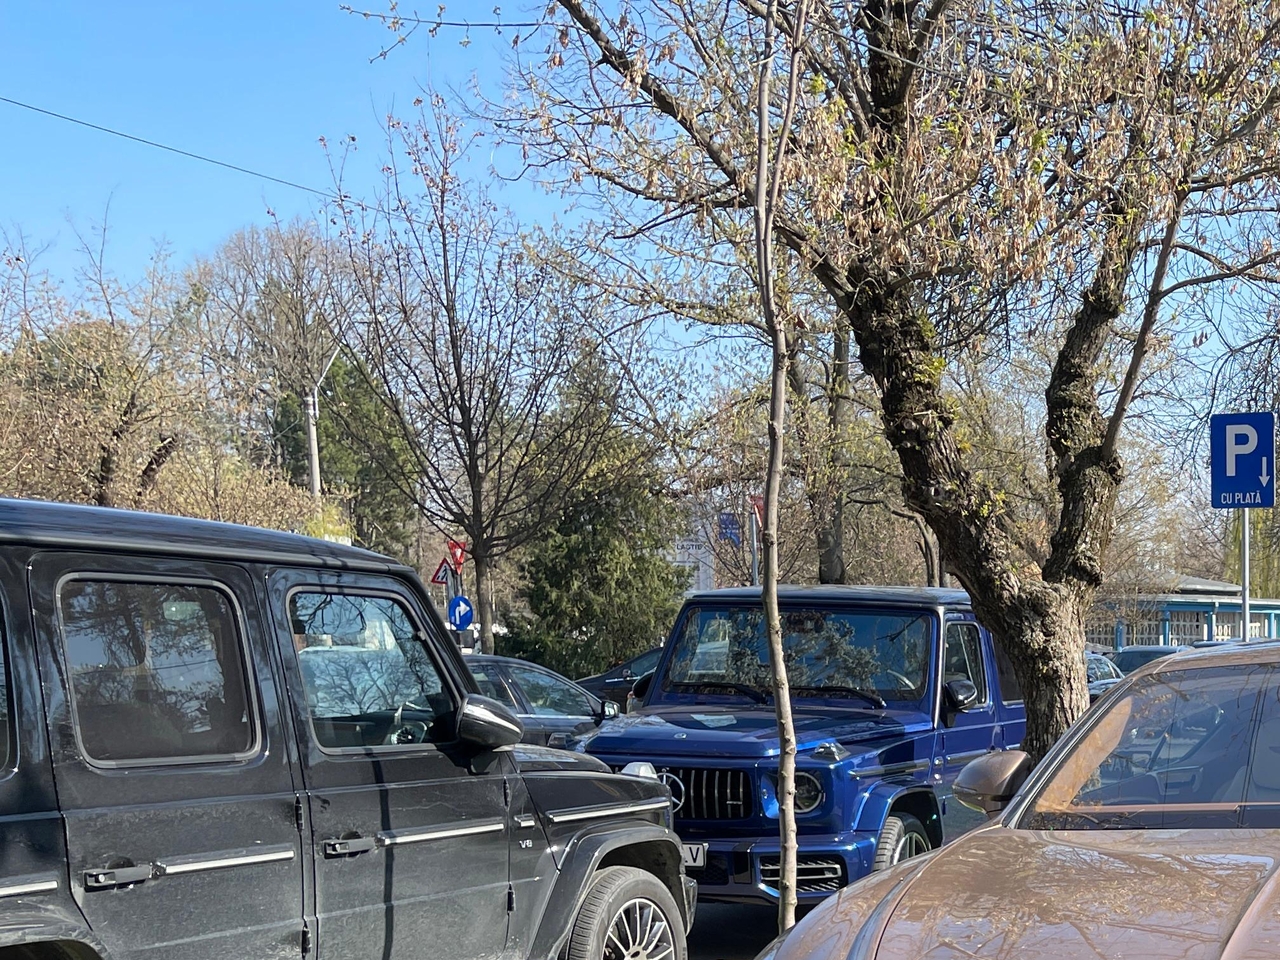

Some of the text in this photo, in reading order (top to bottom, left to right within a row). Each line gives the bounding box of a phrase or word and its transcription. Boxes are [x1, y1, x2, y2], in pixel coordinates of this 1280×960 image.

[1226, 424, 1258, 477] P
[1221, 490, 1262, 504] CU PLATĂ
[519, 839, 533, 849] V8
